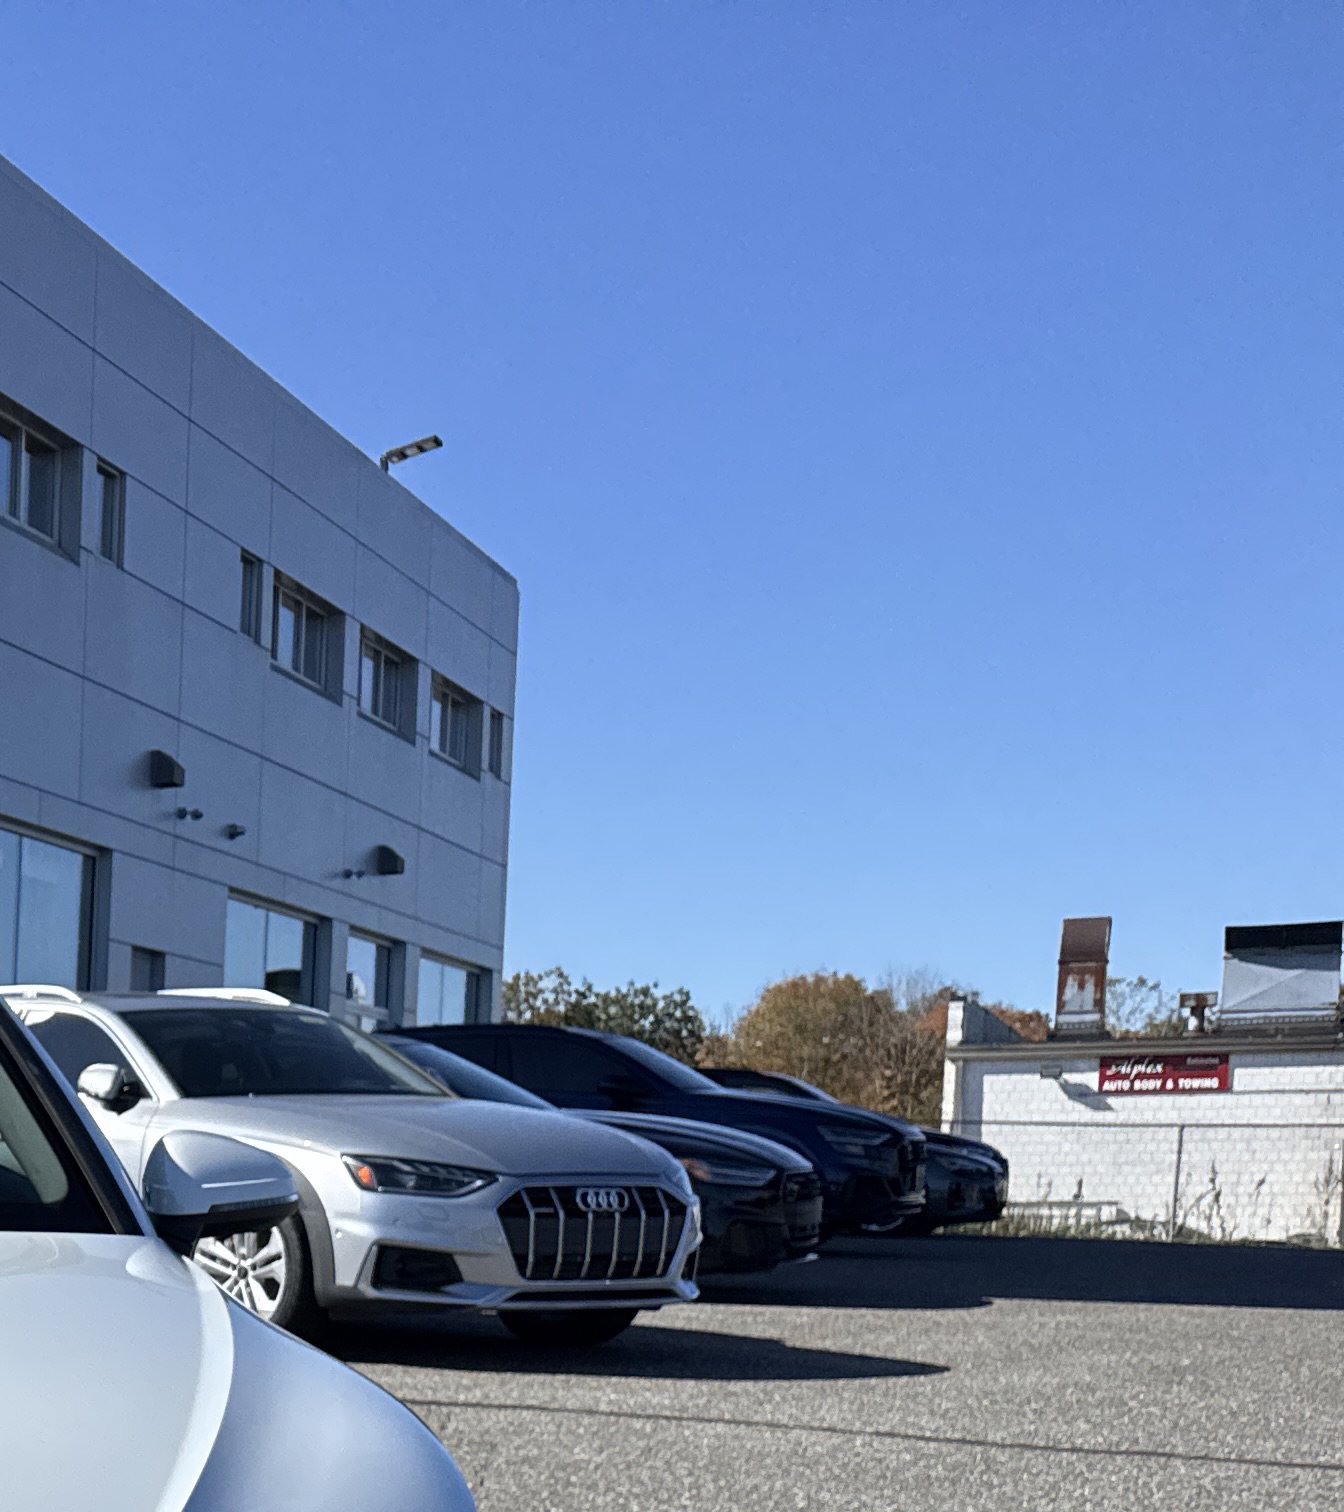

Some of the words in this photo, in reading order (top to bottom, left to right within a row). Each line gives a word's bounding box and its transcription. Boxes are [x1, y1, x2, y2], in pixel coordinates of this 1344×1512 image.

[1102, 1079, 1130, 1092] AUTO
[1134, 1078, 1162, 1091] BODY
[1178, 1077, 1219, 1090] TOWING
